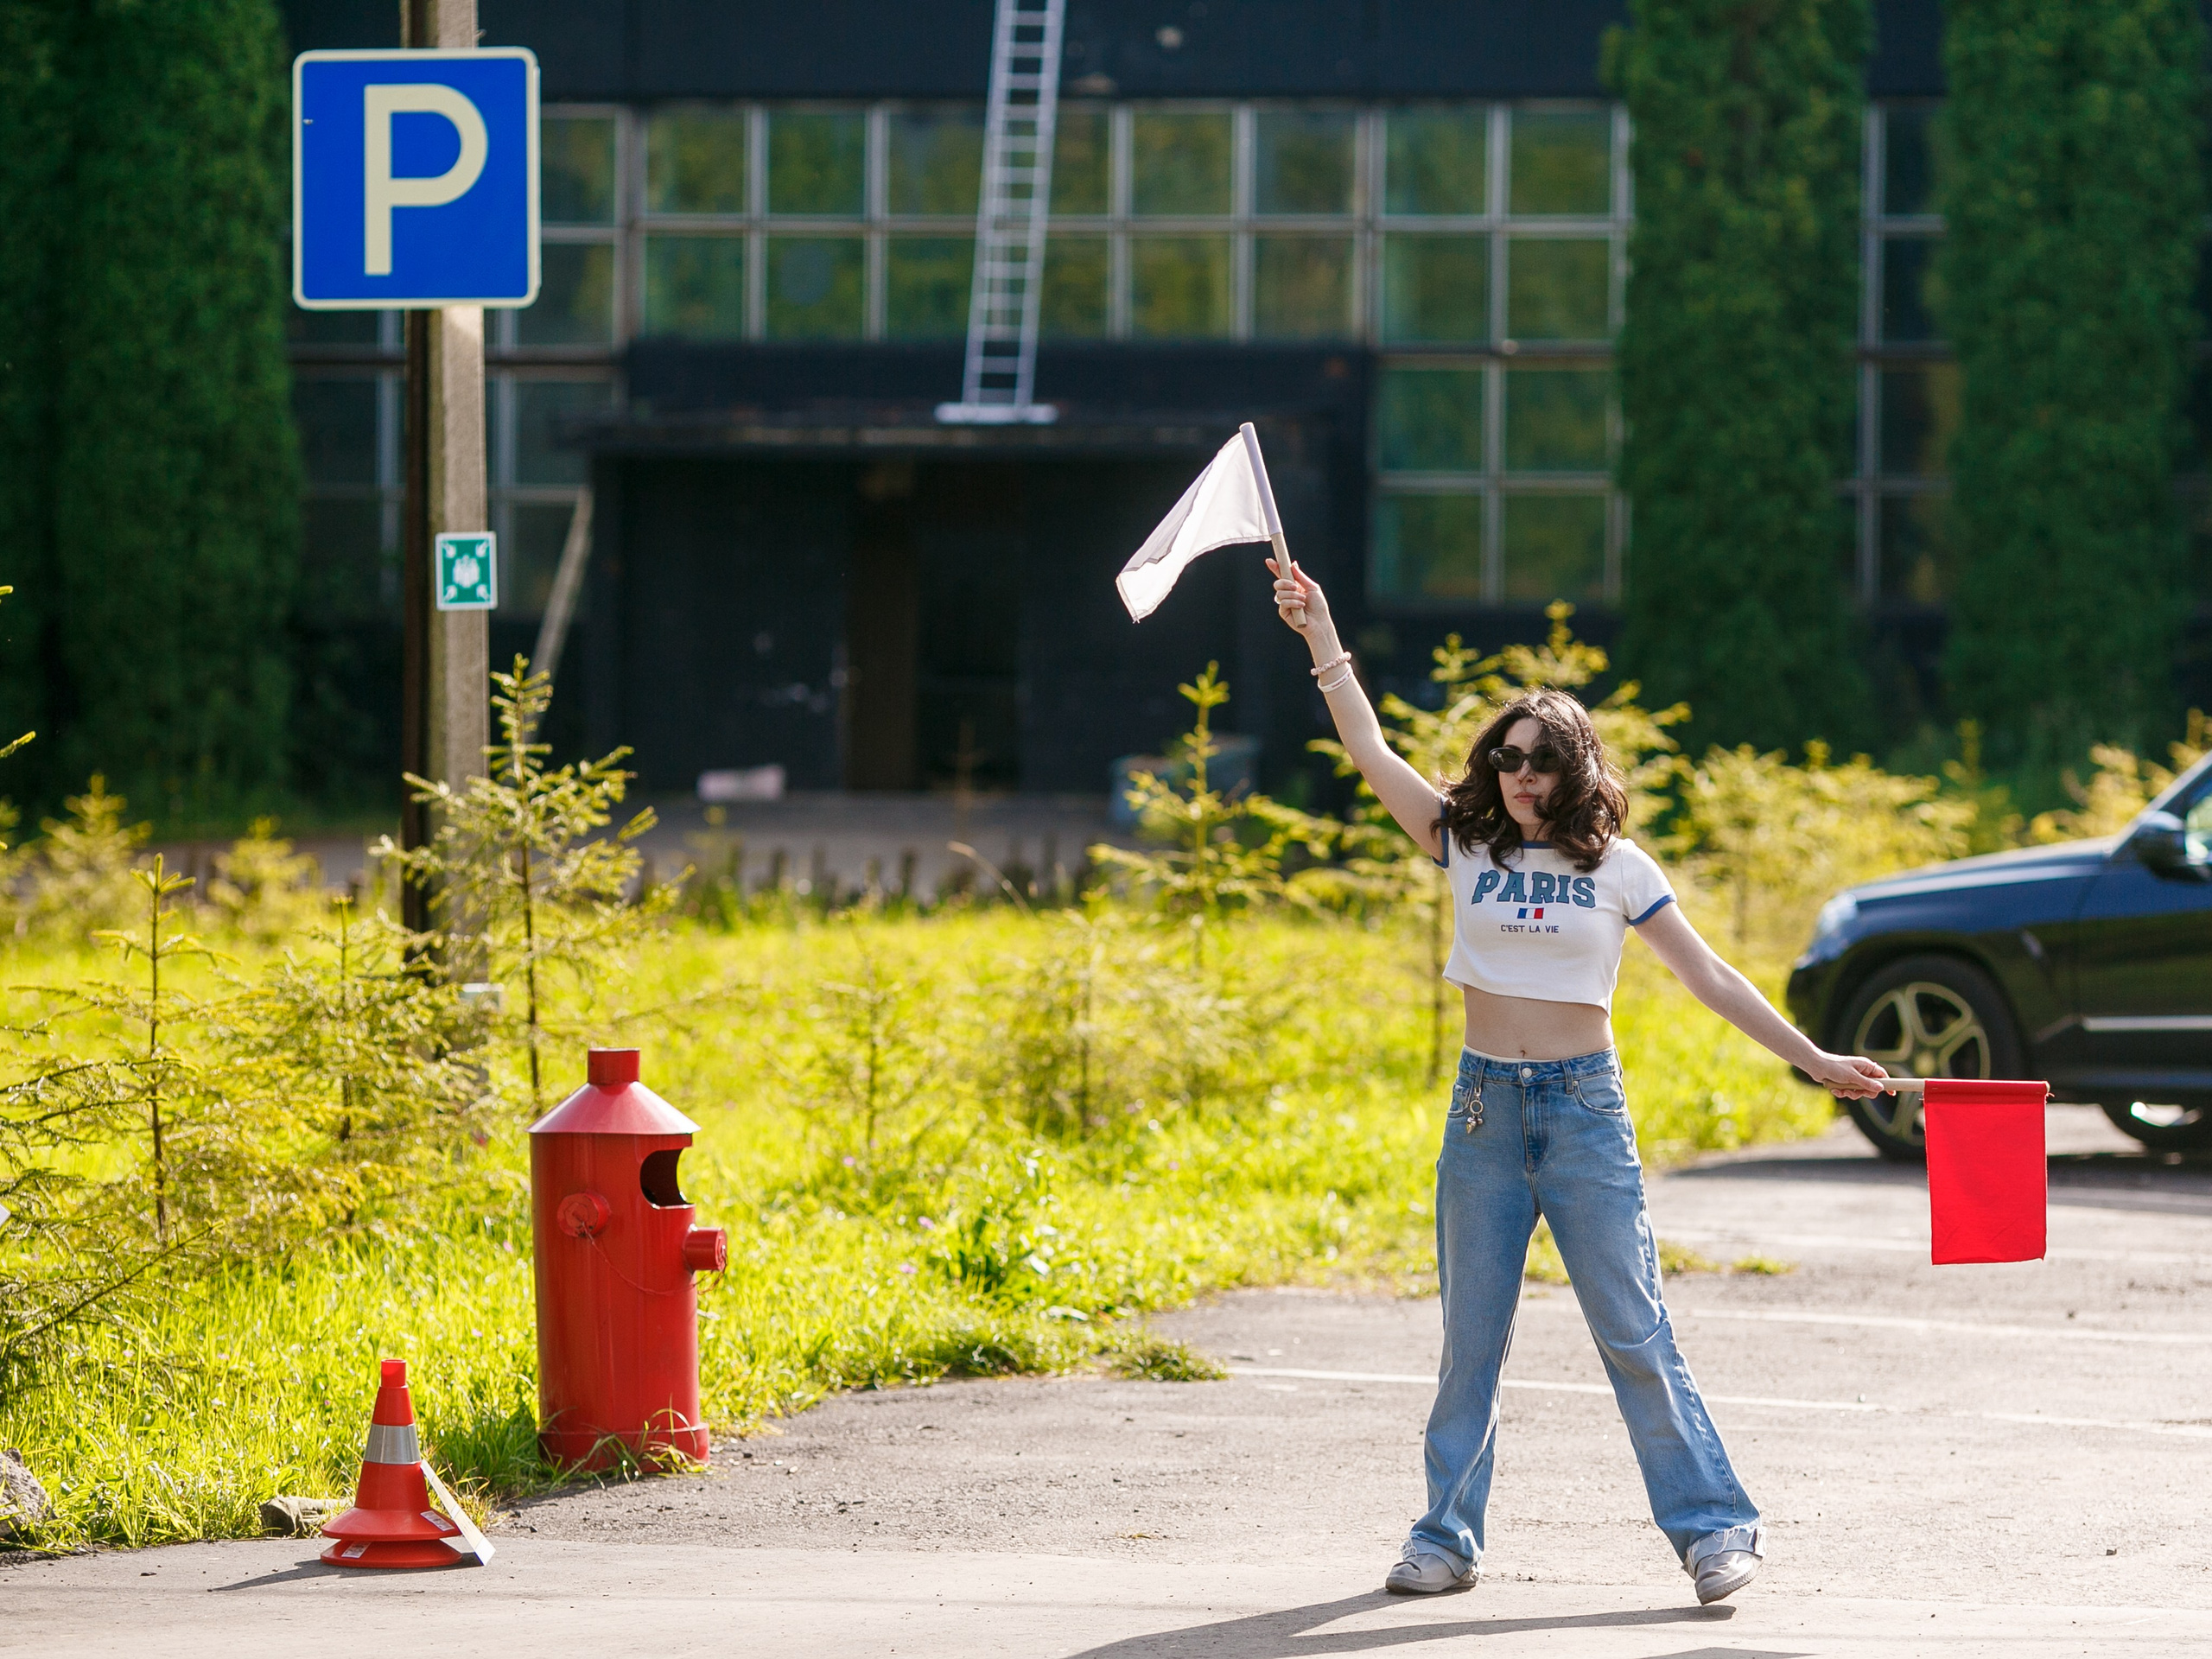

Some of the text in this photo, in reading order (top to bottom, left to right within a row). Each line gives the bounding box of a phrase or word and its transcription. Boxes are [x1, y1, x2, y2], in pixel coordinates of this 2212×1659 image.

[364, 83, 488, 276] P
[1471, 869, 1596, 909] PARIS
[1500, 924, 1560, 934] C'EST LA VIE
